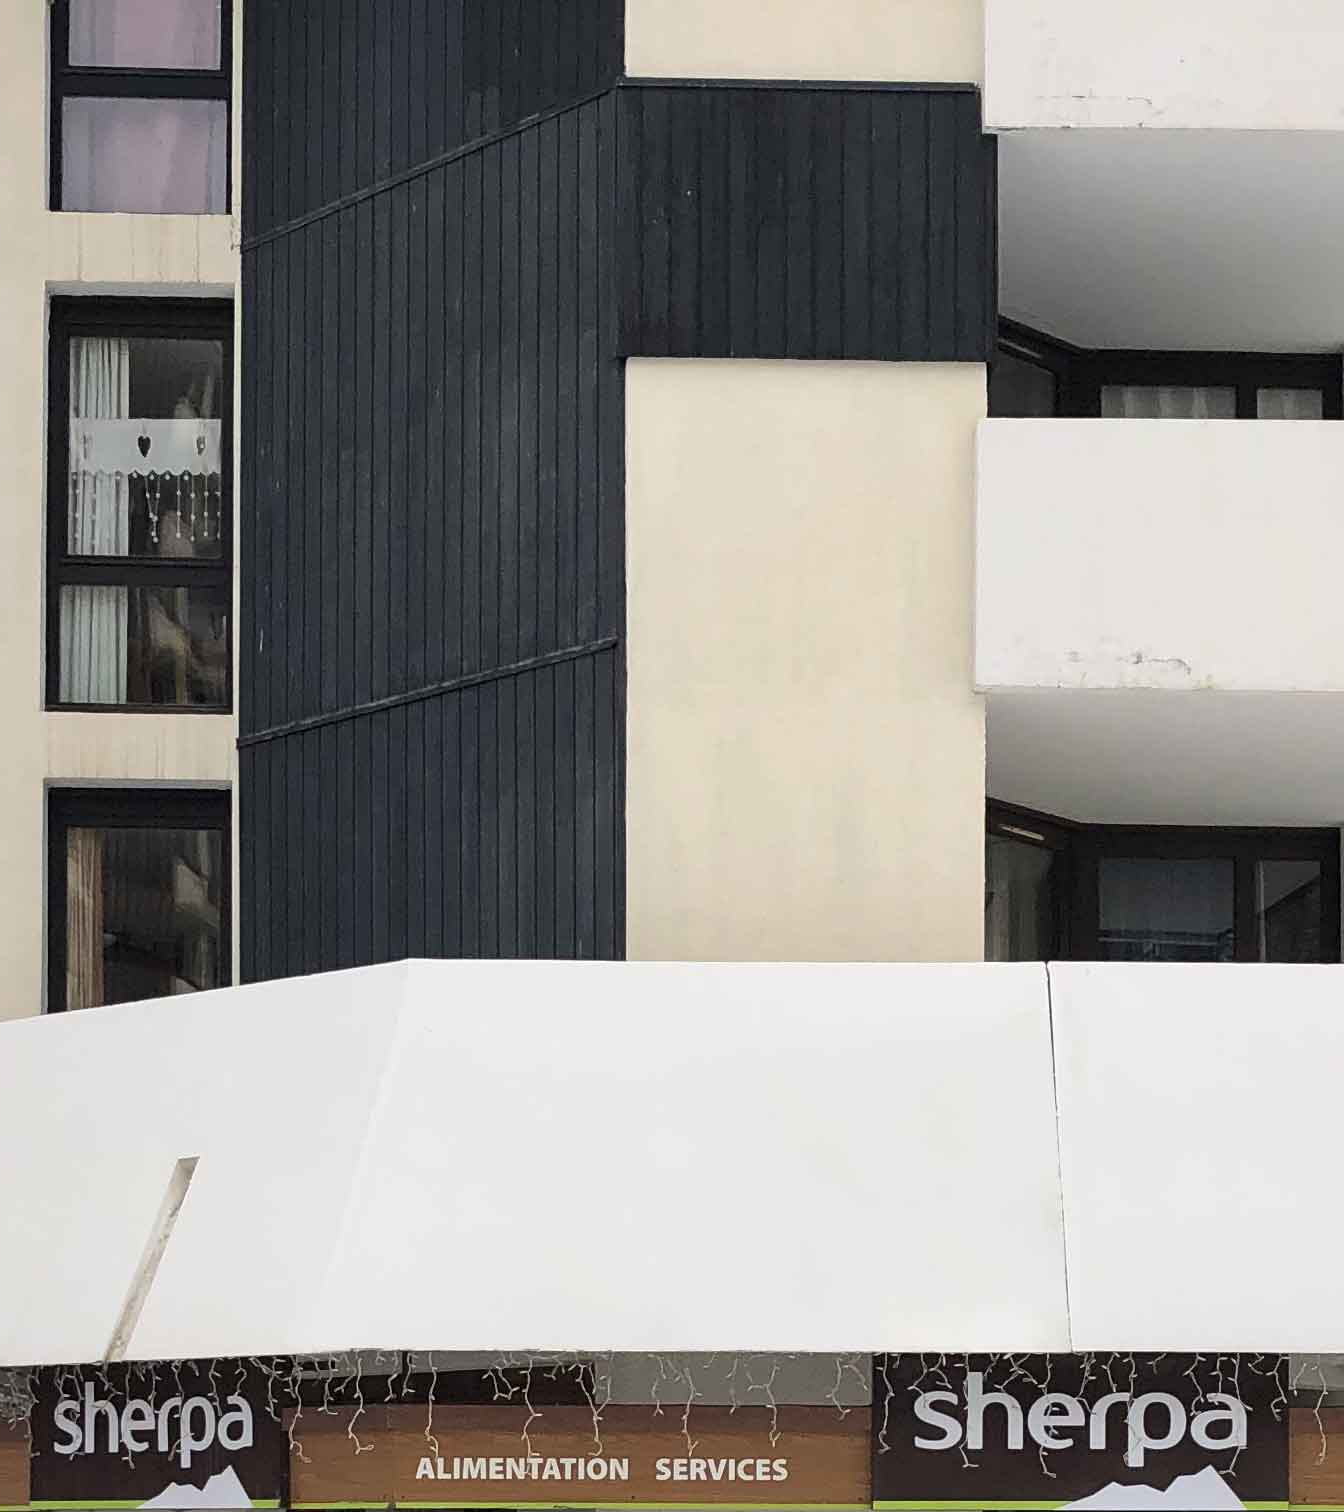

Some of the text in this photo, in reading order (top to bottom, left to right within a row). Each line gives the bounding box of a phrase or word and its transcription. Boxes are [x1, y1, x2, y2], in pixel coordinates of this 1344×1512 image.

[53, 1381, 254, 1468] sherpa
[913, 1371, 1248, 1467] sherpa
[415, 1457, 789, 1481] ALIMENTATION SERVICES
